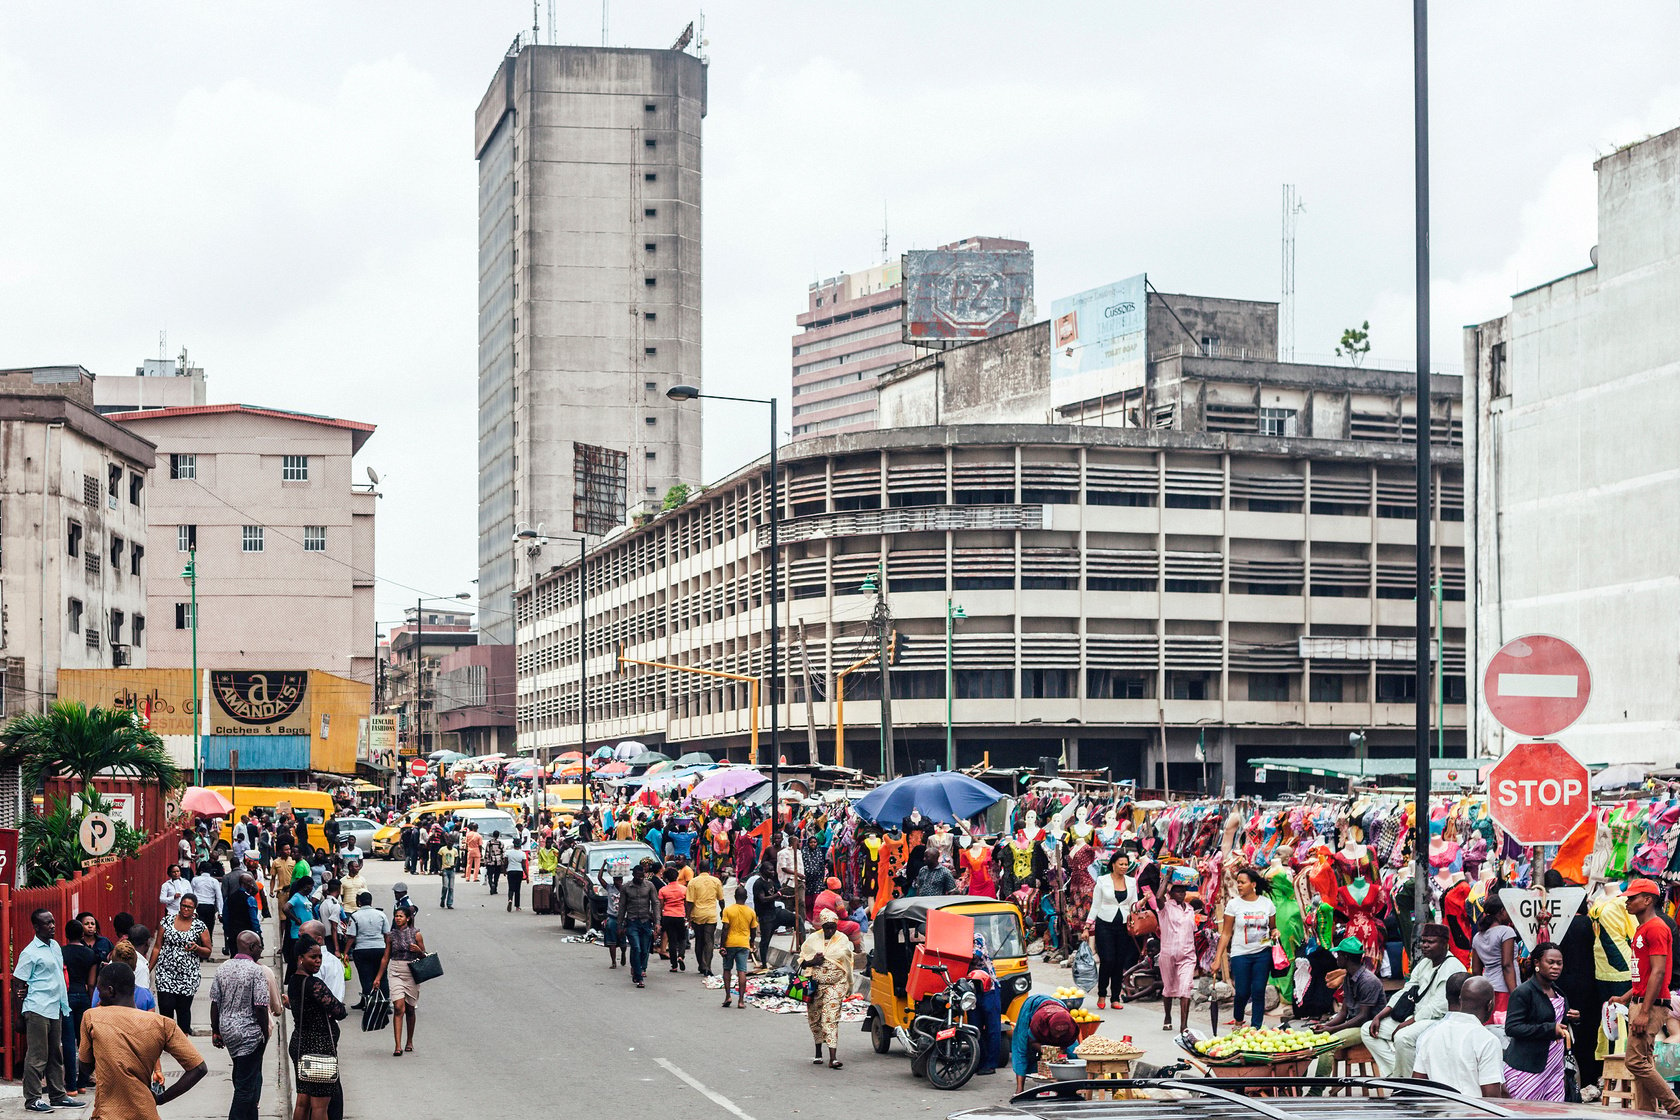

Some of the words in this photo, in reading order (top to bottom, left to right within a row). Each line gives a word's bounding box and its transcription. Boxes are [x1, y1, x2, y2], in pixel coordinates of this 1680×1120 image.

[1104, 301, 1136, 319] Cussons
[220, 685, 297, 718] AMANDA'S
[215, 726, 259, 734] Clothes
[265, 726, 272, 734] &
[278, 726, 305, 735] Bags
[1498, 779, 1582, 807] STOP
[1520, 900, 1561, 918] GIVE
[1529, 923, 1556, 934] WY
